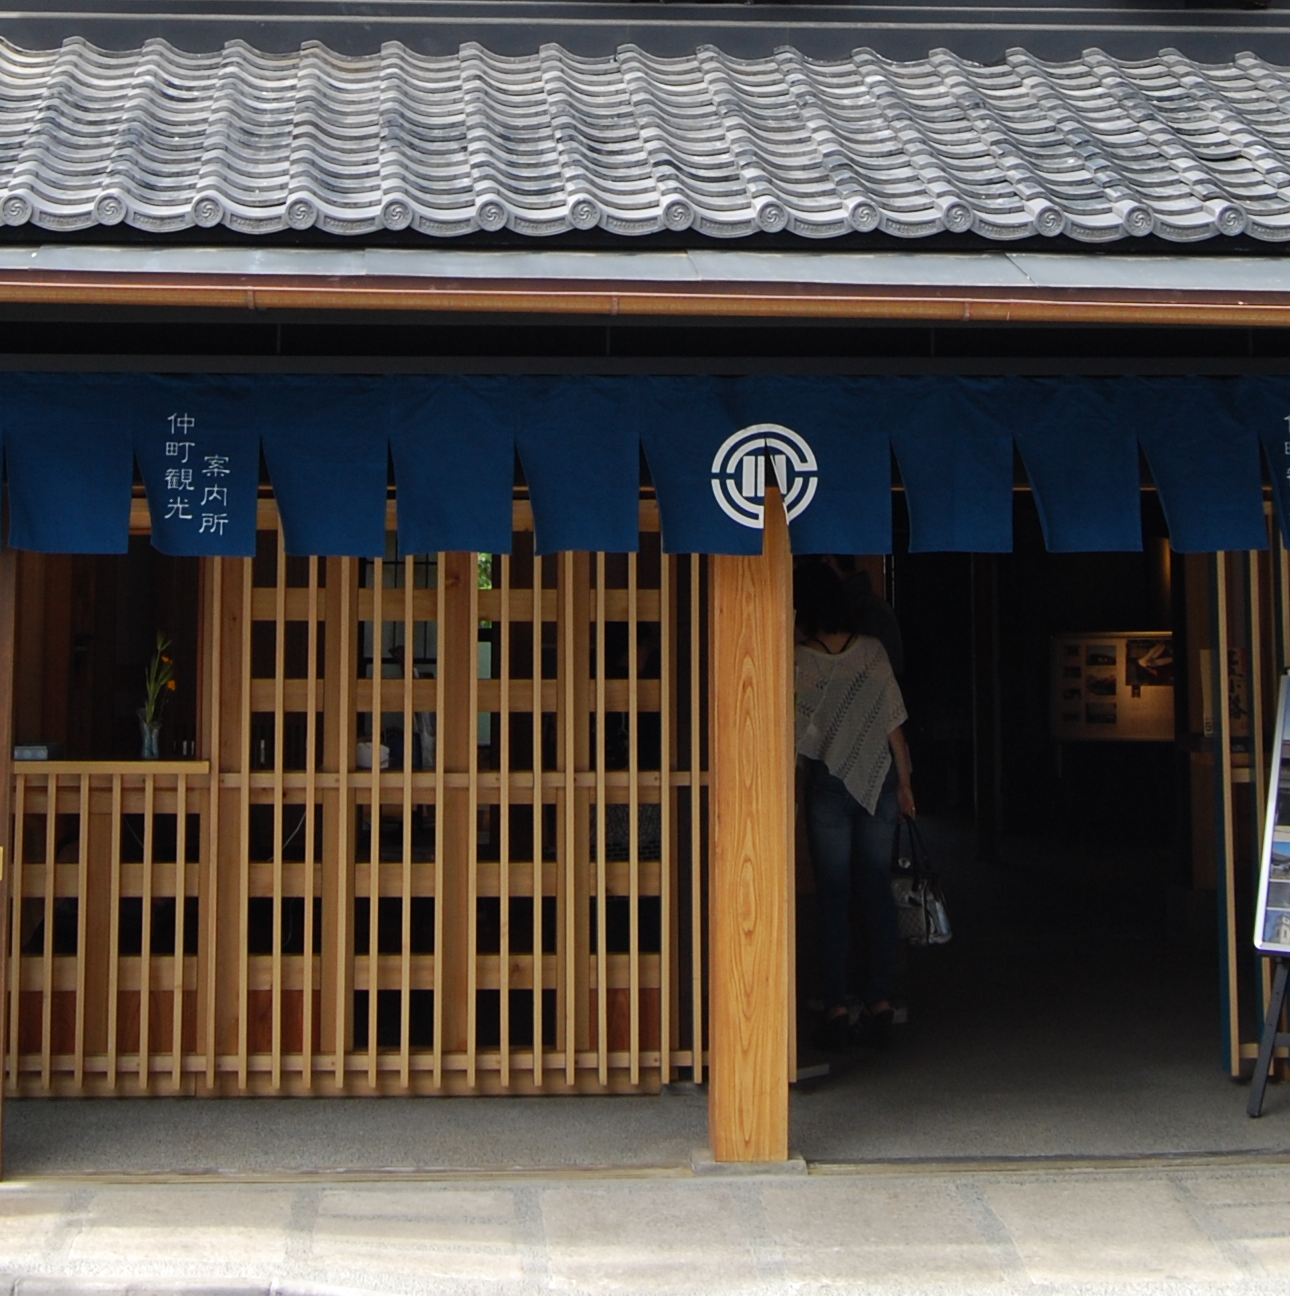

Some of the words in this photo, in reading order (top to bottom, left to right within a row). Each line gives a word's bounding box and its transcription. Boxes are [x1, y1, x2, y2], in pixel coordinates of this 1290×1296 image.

[164, 412, 196, 519] 仲町観光
[198, 454, 230, 536] 案内所
